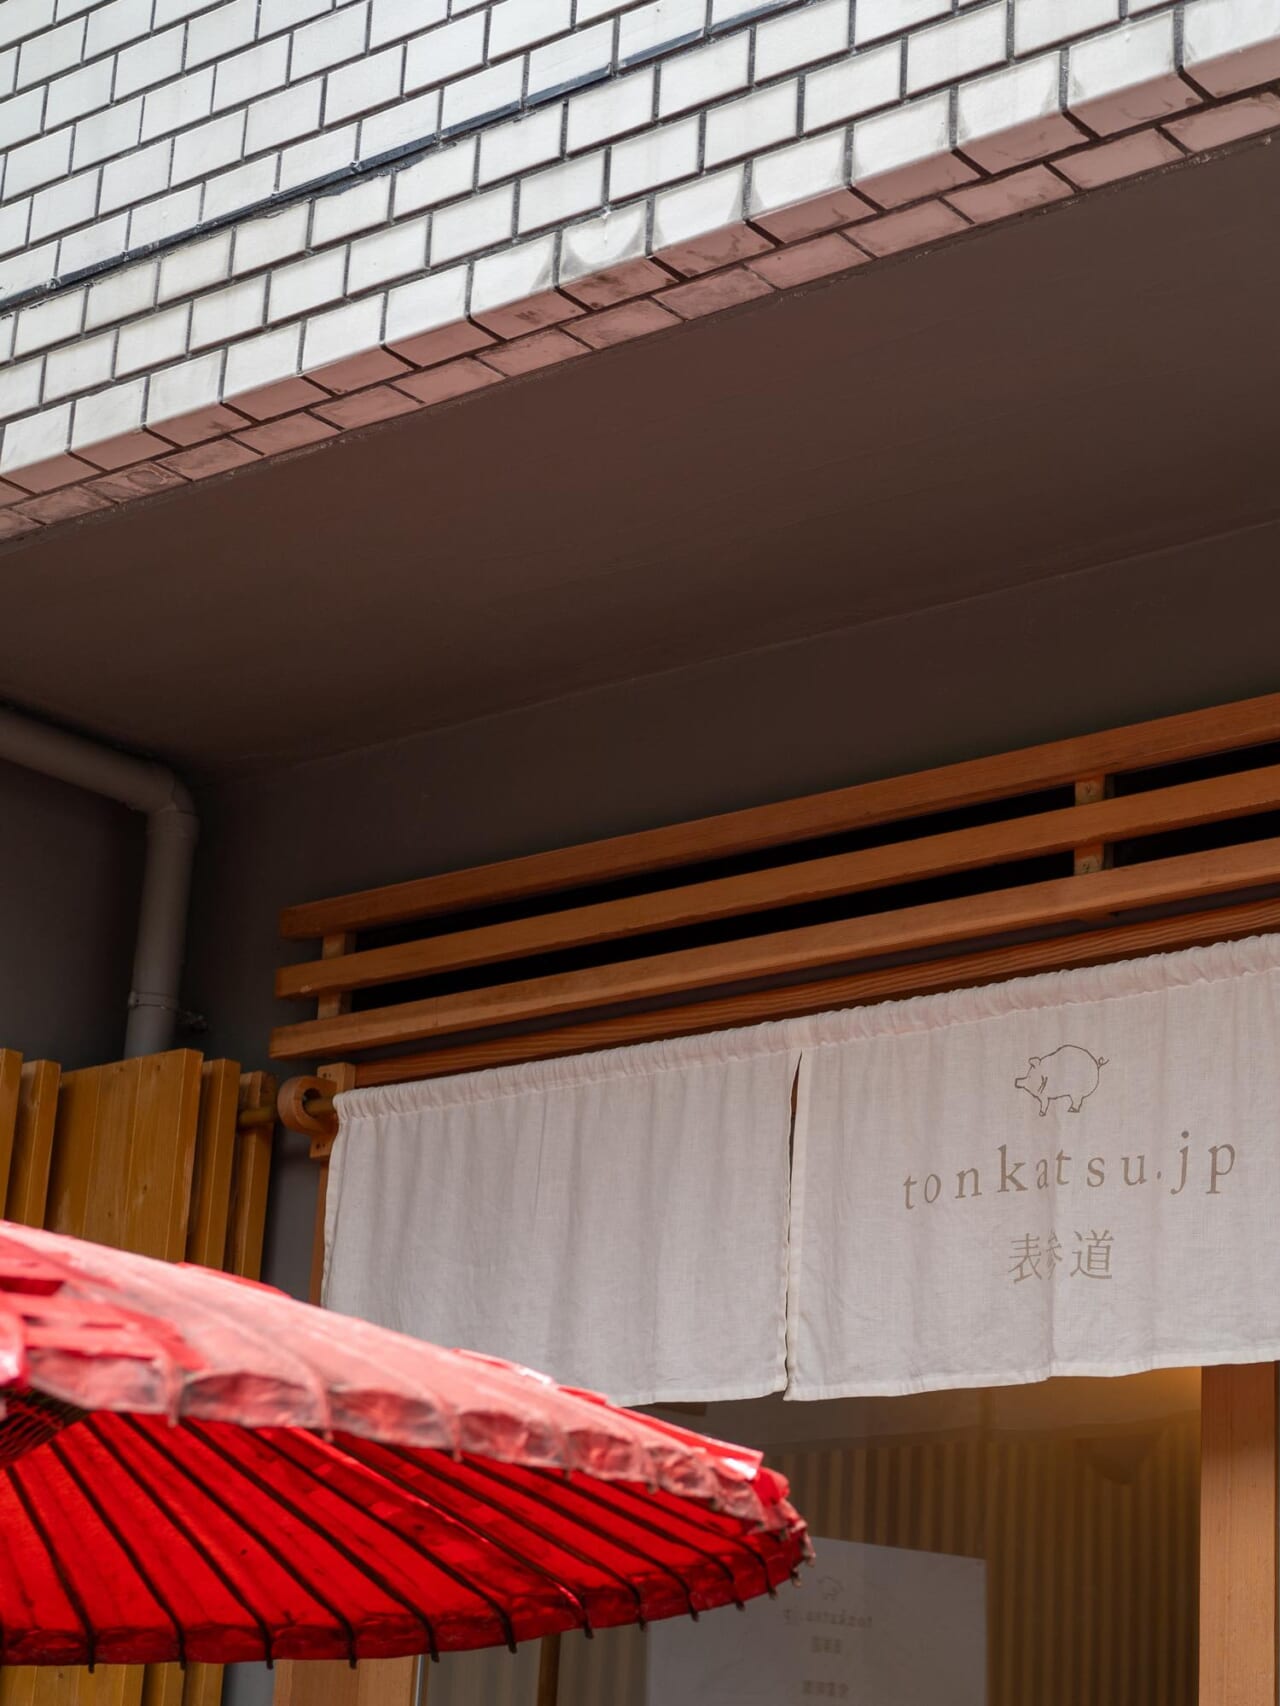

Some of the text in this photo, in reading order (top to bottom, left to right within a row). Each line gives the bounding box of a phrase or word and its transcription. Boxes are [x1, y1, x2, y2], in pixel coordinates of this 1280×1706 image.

[903, 1131, 1236, 1210] tonkatsu.jp
[1008, 1229, 1114, 1284] 表参道
